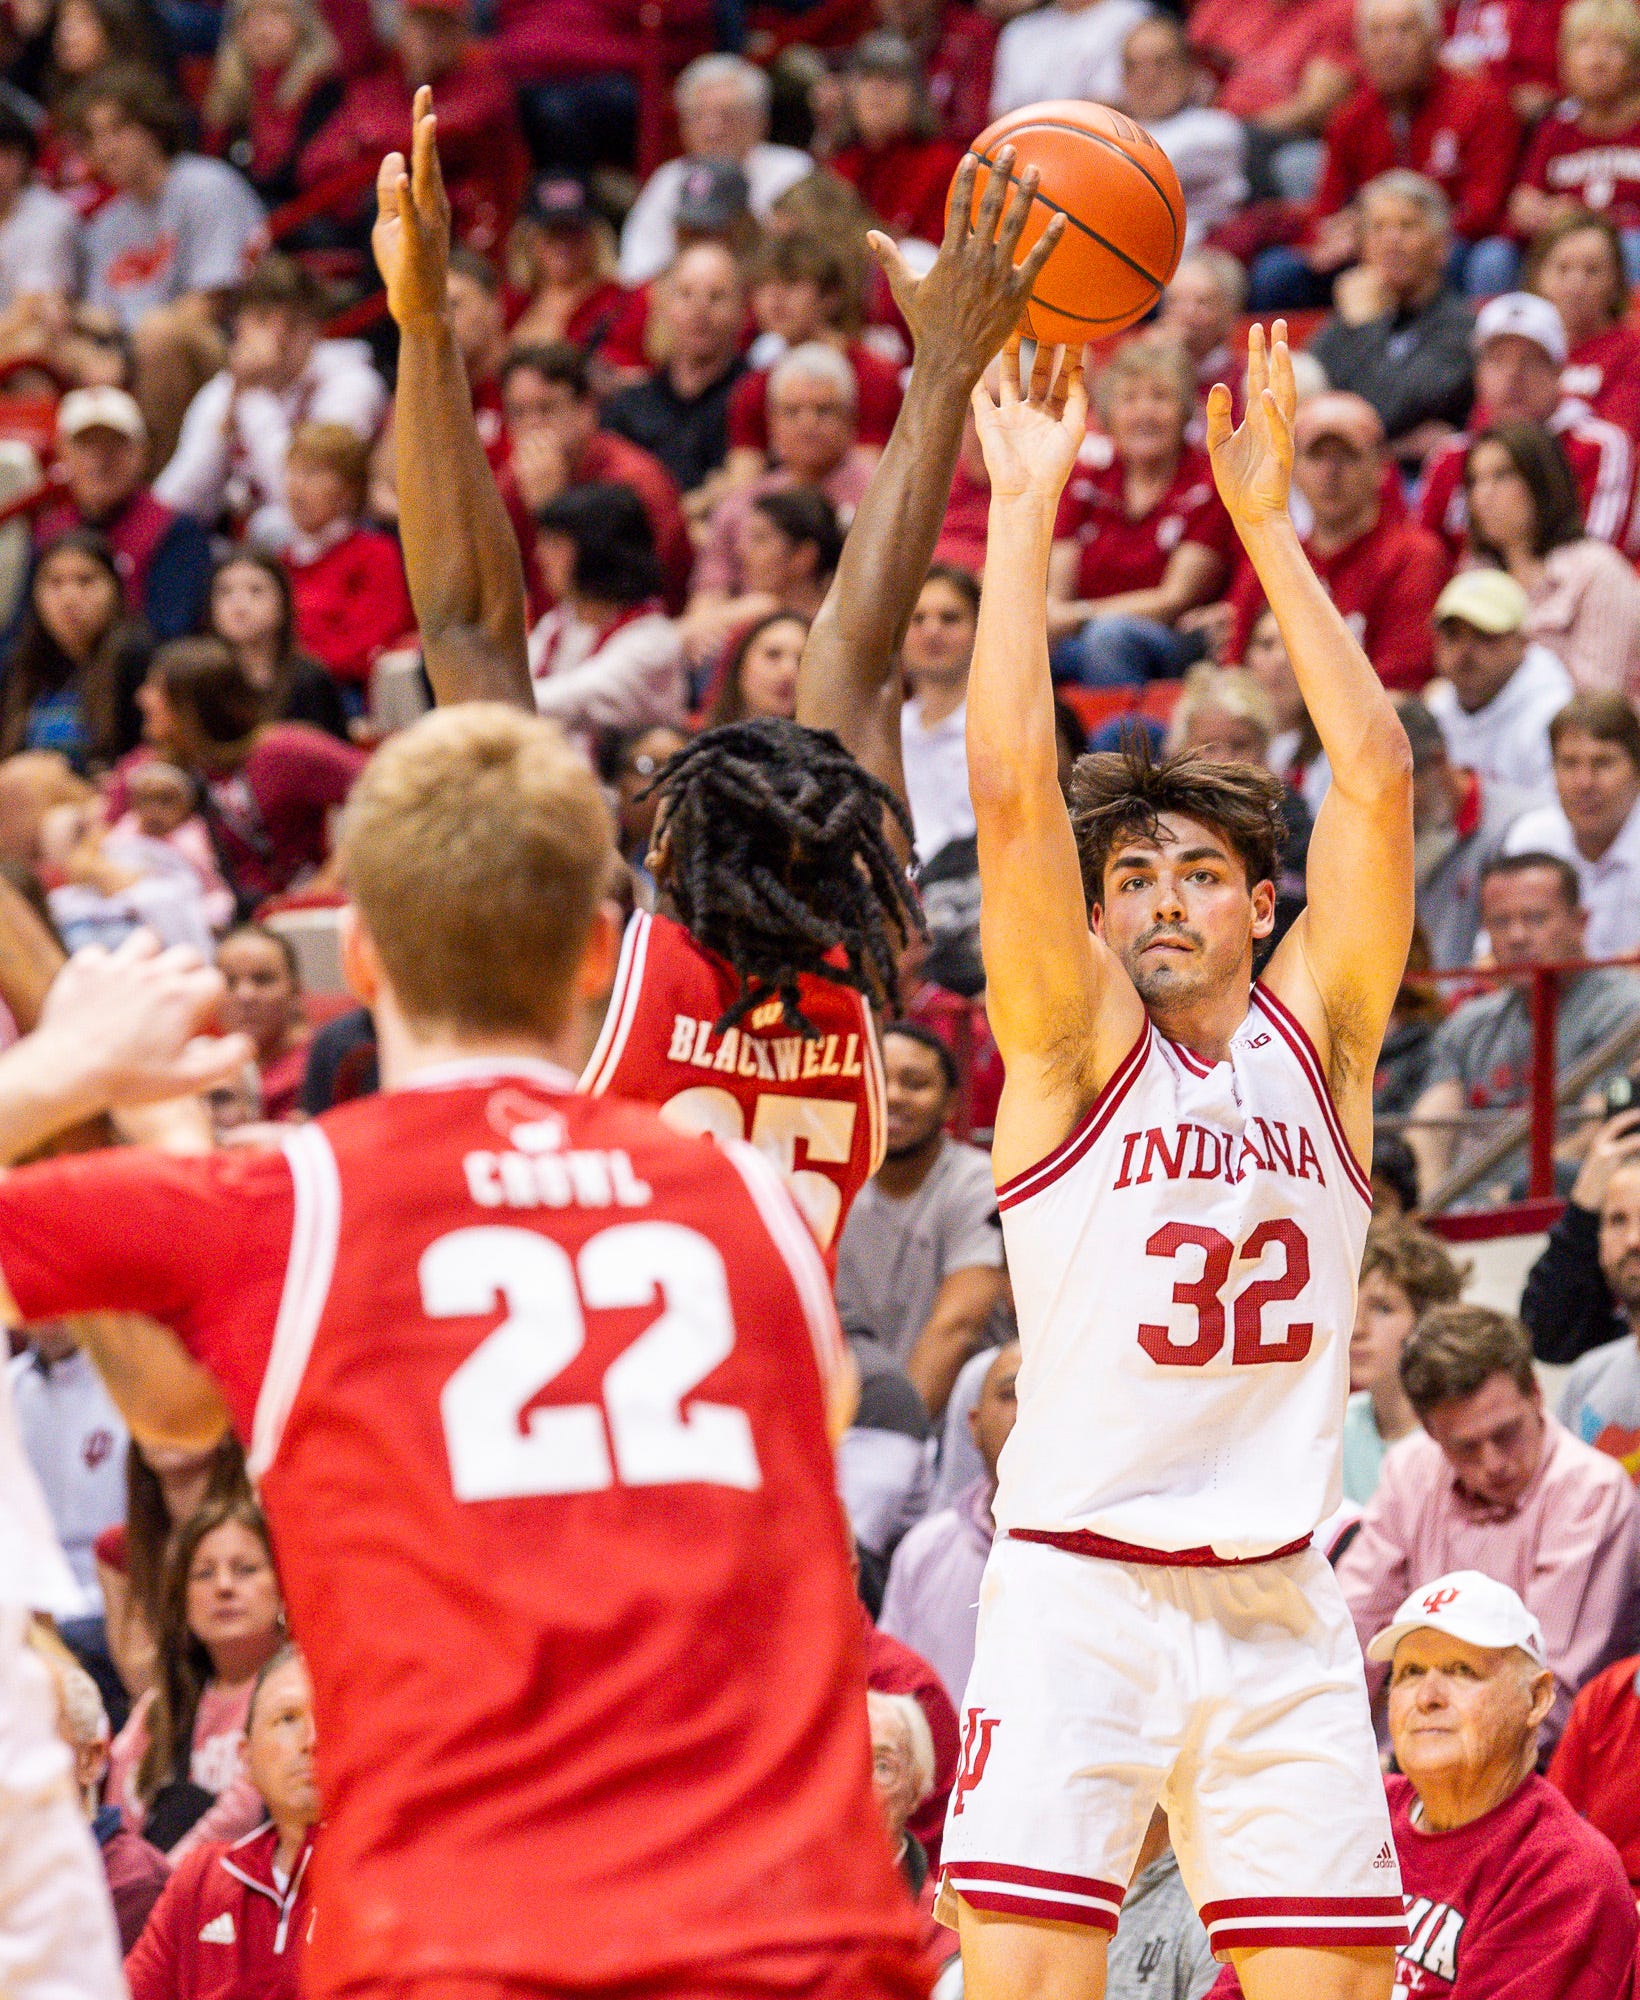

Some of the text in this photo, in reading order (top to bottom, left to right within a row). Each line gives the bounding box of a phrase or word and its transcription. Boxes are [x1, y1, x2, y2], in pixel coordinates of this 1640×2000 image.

[668, 1014, 862, 1082] BLACKWELL
[464, 1148, 653, 1209] CROWL
[1113, 1116, 1326, 1191] INDIANA
[1137, 1218, 1314, 1366] 32
[417, 1219, 765, 1503] 22
